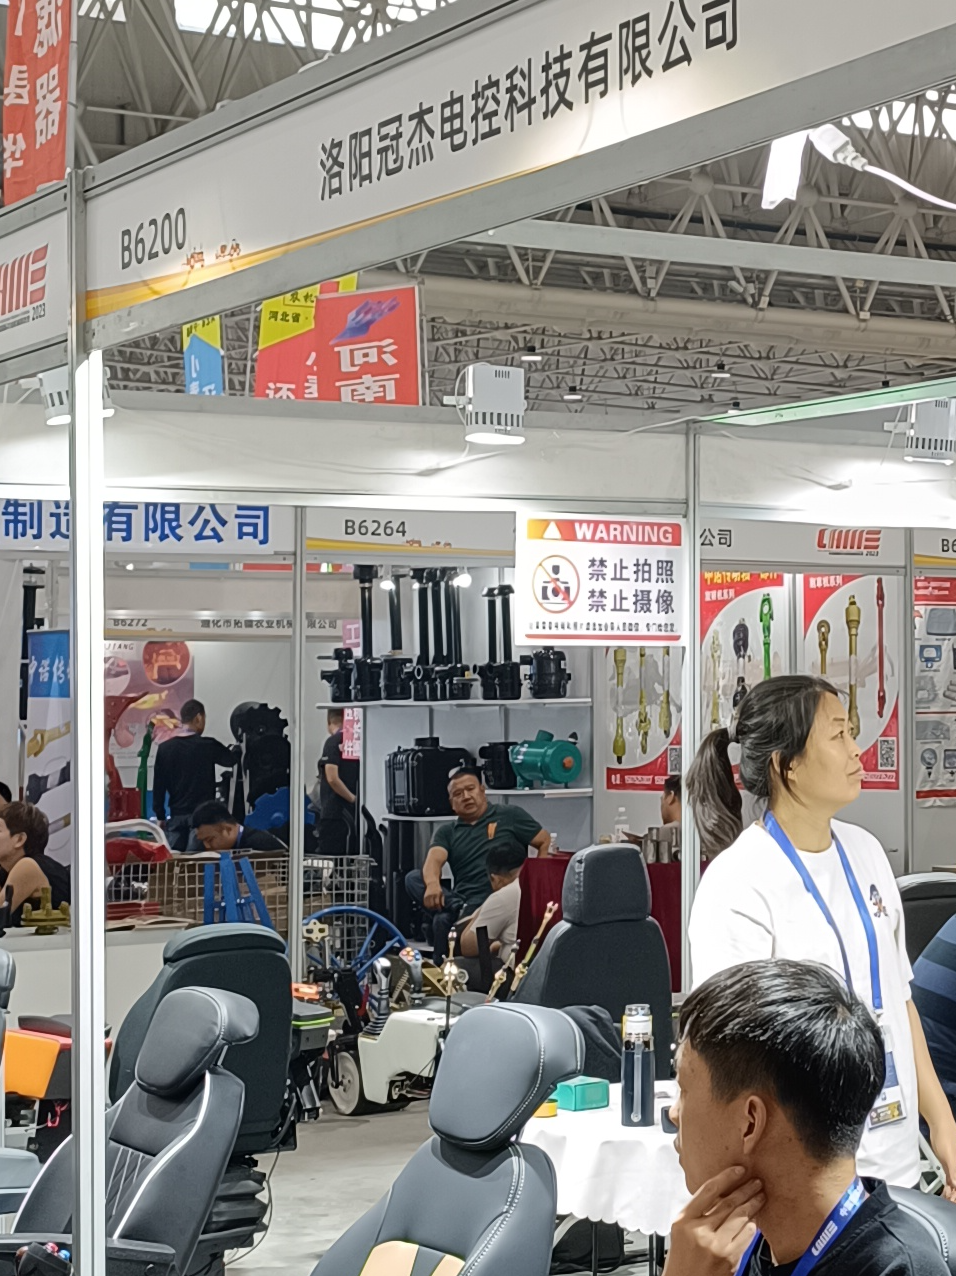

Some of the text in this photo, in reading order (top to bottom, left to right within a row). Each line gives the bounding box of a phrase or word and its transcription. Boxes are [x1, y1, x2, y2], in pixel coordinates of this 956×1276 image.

[319, 0, 738, 201] 洛阳冠杰电控科技有限公司
[120, 207, 187, 270] B6200
[343, 518, 407, 538] B6264
[574, 521, 673, 543] WARNING
[699, 528, 732, 548] 公司
[587, 556, 675, 584] 禁止拍照
[587, 588, 675, 615] 禁止摄像
[29, 654, 70, 685] 中诺传
